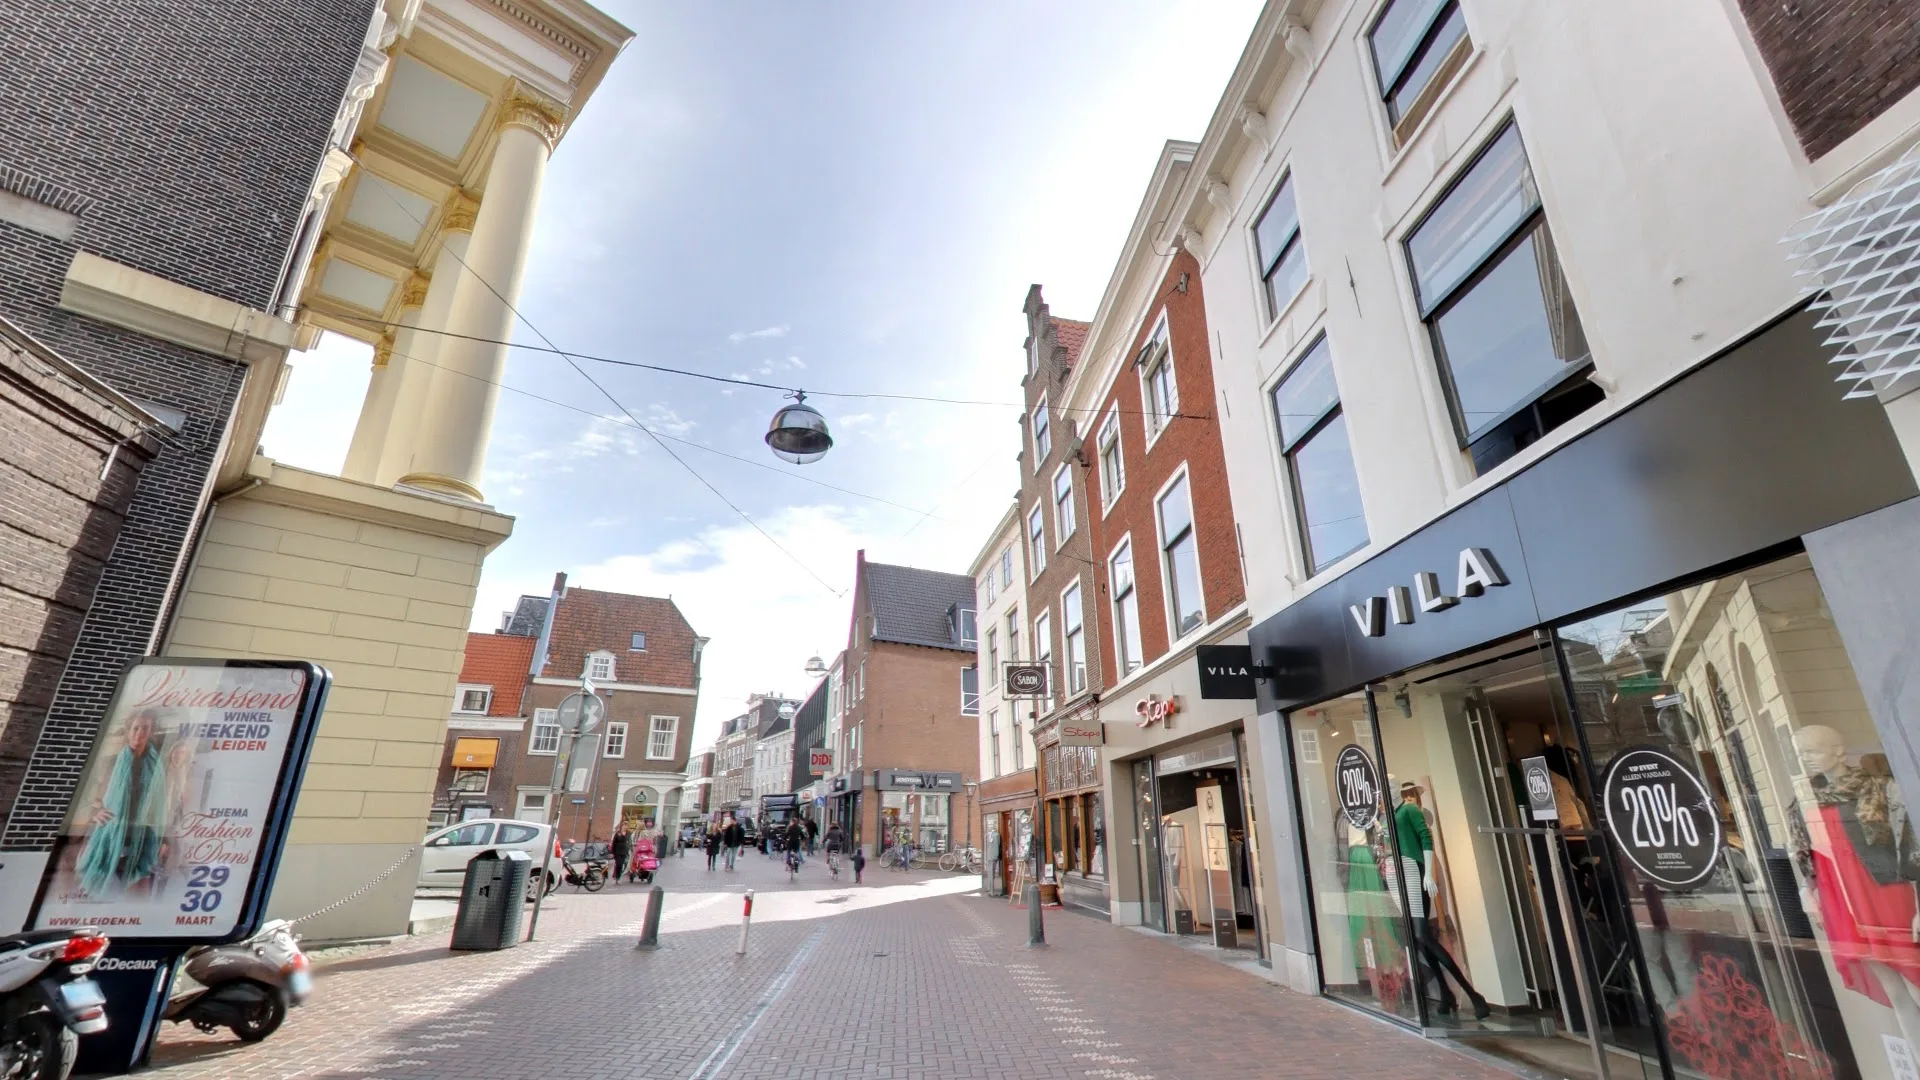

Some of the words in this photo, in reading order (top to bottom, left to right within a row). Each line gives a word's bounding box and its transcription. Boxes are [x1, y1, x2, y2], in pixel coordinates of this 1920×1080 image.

[1350, 548, 1509, 637] VILA
[1207, 666, 1248, 675] VILA
[1017, 674, 1038, 686] SABON
[133, 667, 307, 710] Verrassend
[224, 711, 273, 723] WINKEL
[1136, 697, 1178, 729] Steps
[178, 723, 271, 739] WEEKEND
[1062, 727, 1101, 740] Steps
[212, 740, 267, 751] LEIDEN
[811, 753, 832, 765] DiDi
[1639, 763, 1659, 771] EVENT
[1621, 773, 1642, 781] ALLEEN
[1343, 766, 1373, 807] 20%
[1529, 775, 1548, 794] 20%
[209, 808, 249, 817] THEMA
[1621, 782, 1699, 848] 20%
[176, 812, 254, 838] Fashion
[188, 838, 252, 865] Dans
[187, 866, 230, 888] 29
[180, 889, 222, 912] 30
[48, 917, 142, 926] WWW.LEIDEN.NL
[175, 916, 216, 925] MAART
[95, 958, 158, 970] CDecaux
